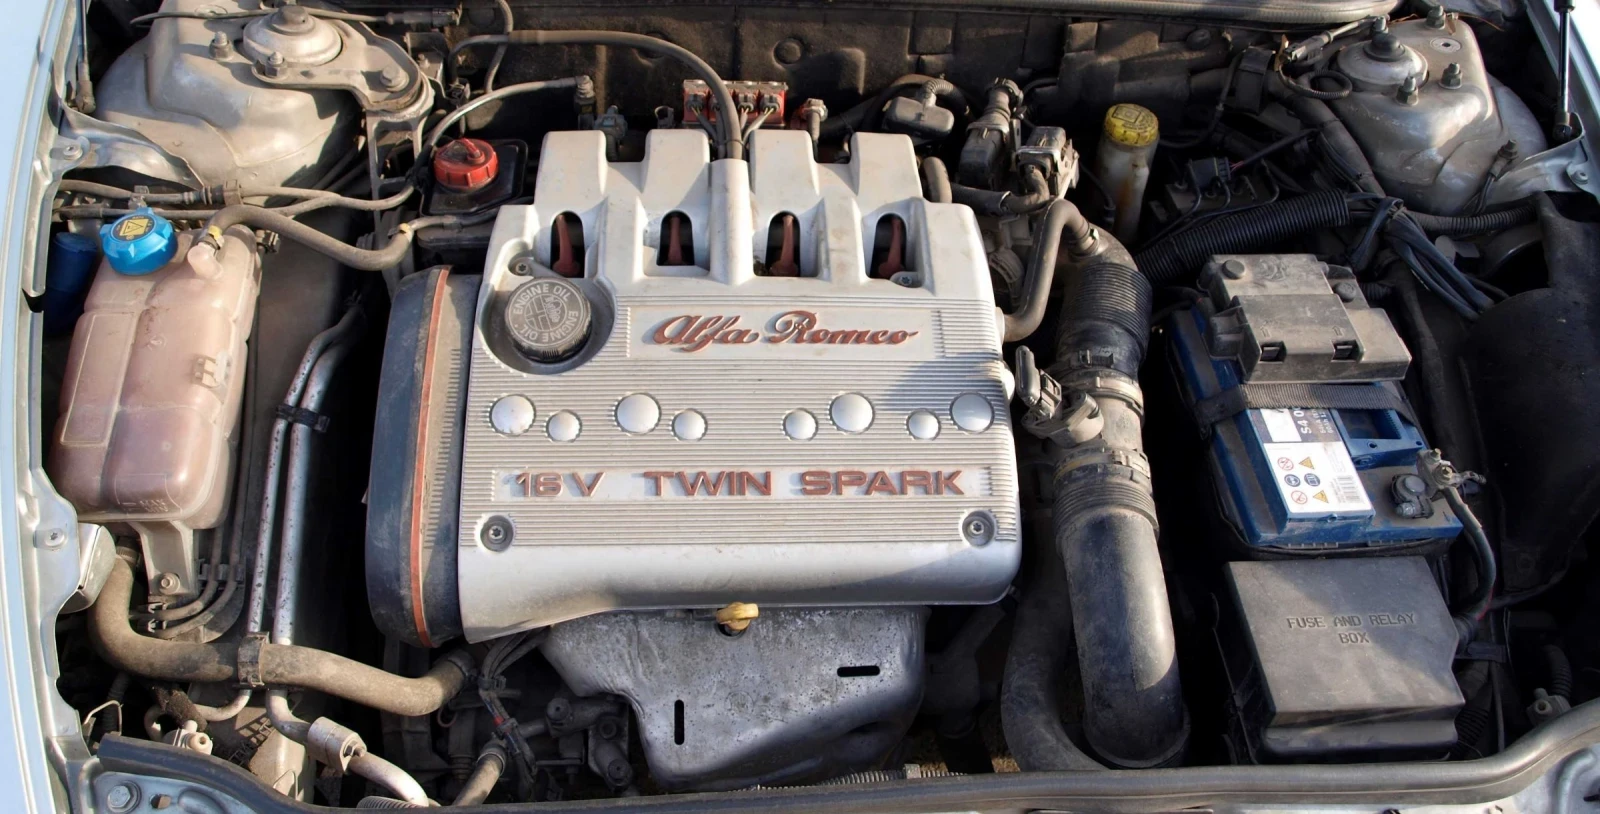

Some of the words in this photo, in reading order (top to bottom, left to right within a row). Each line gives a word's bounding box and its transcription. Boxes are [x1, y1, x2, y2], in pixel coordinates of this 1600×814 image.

[513, 283, 549, 315] ENGINE
[553, 285, 571, 301] OIL
[519, 323, 538, 341] OIL
[541, 310, 579, 342] ENGINE
[652, 315, 759, 352] Alfa
[769, 310, 919, 346] Romeo
[643, 470, 772, 496] TWIN
[800, 470, 964, 496] SPARK
[1286, 616, 1326, 629] FUSE
[1333, 615, 1363, 628] AND
[1369, 613, 1416, 626] RELAY
[1338, 632, 1370, 644] BOX
